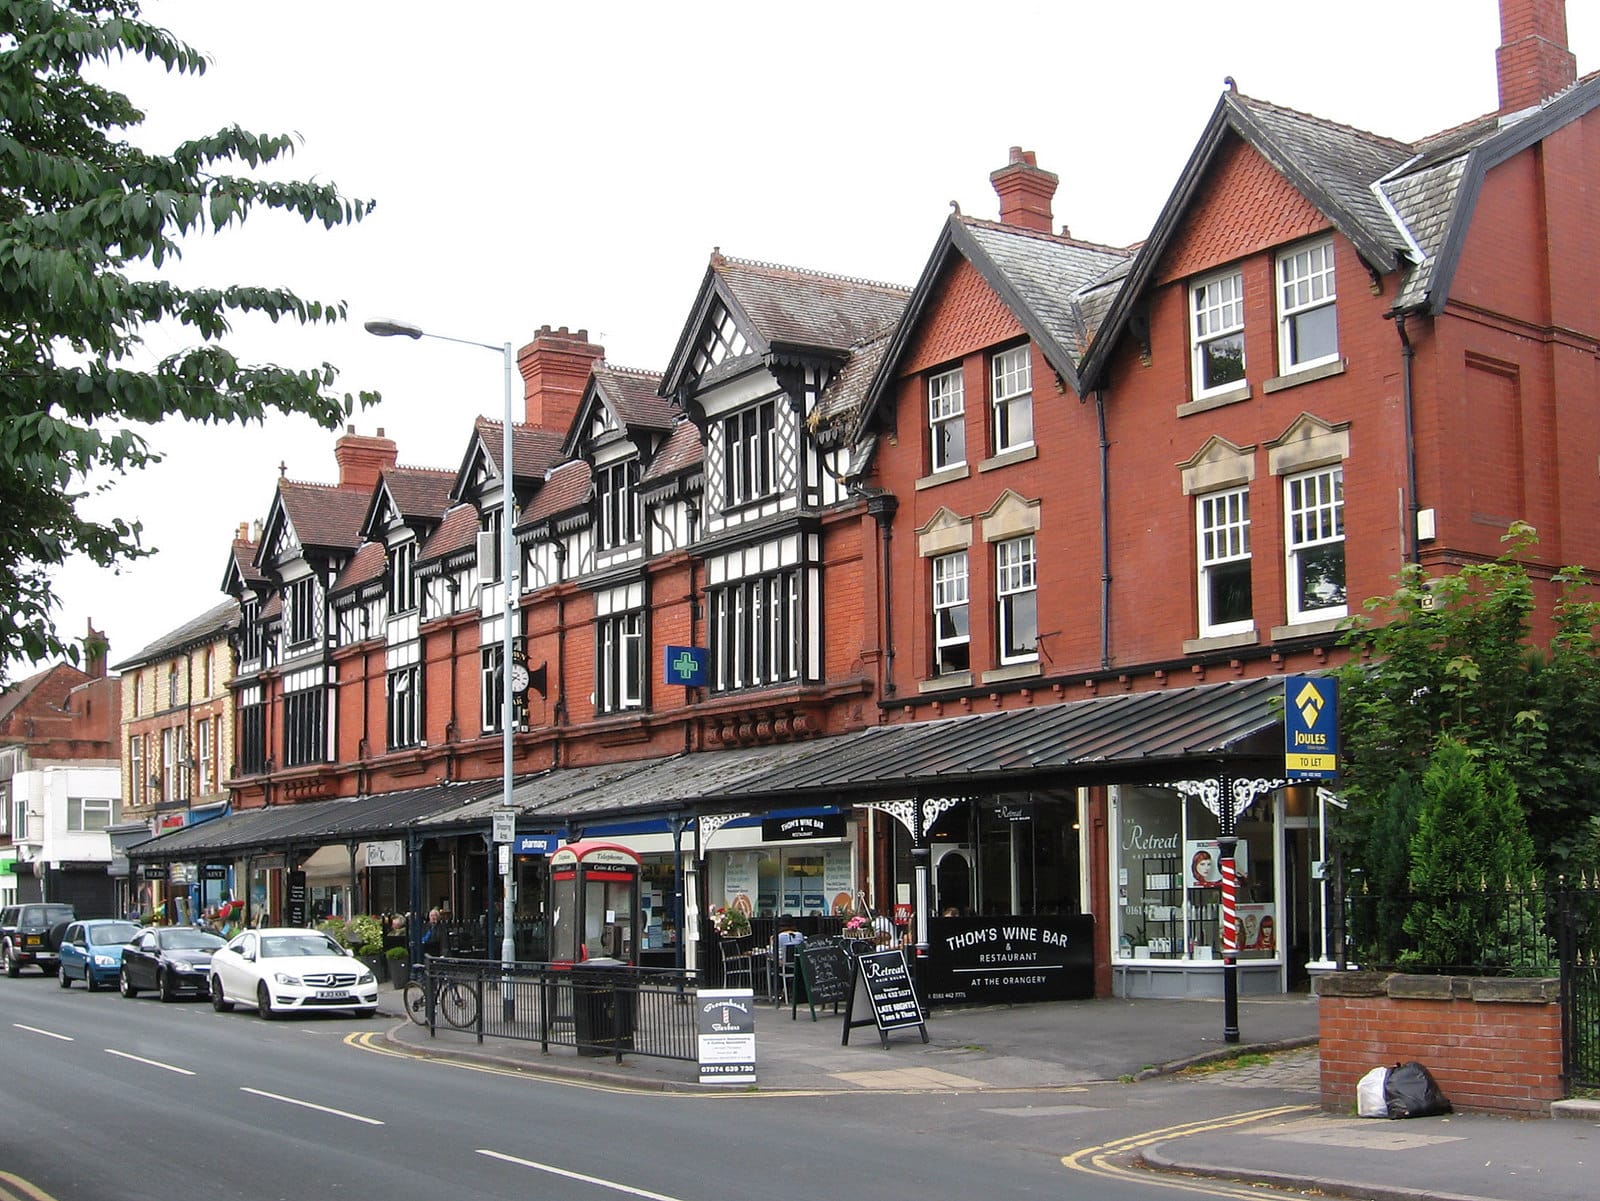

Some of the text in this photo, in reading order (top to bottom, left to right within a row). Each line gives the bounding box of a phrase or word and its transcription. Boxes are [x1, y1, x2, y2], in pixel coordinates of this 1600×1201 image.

[1295, 730, 1326, 745] JOULES
[1300, 757, 1322, 767] TO LET
[800, 819, 813, 828] WINE
[814, 820, 824, 829] BAR
[1122, 825, 1178, 850] Retreat
[522, 838, 547, 850] pharmacy
[946, 926, 1068, 951] THOM'S WINE BAR
[1005, 943, 1011, 951] &
[979, 952, 1038, 962] RESTAURANT
[867, 963, 904, 978] Retreat
[984, 977, 1000, 985] THE
[1002, 976, 1046, 985] ORANGERY
[877, 1001, 915, 1014] LATE NIGHTS
